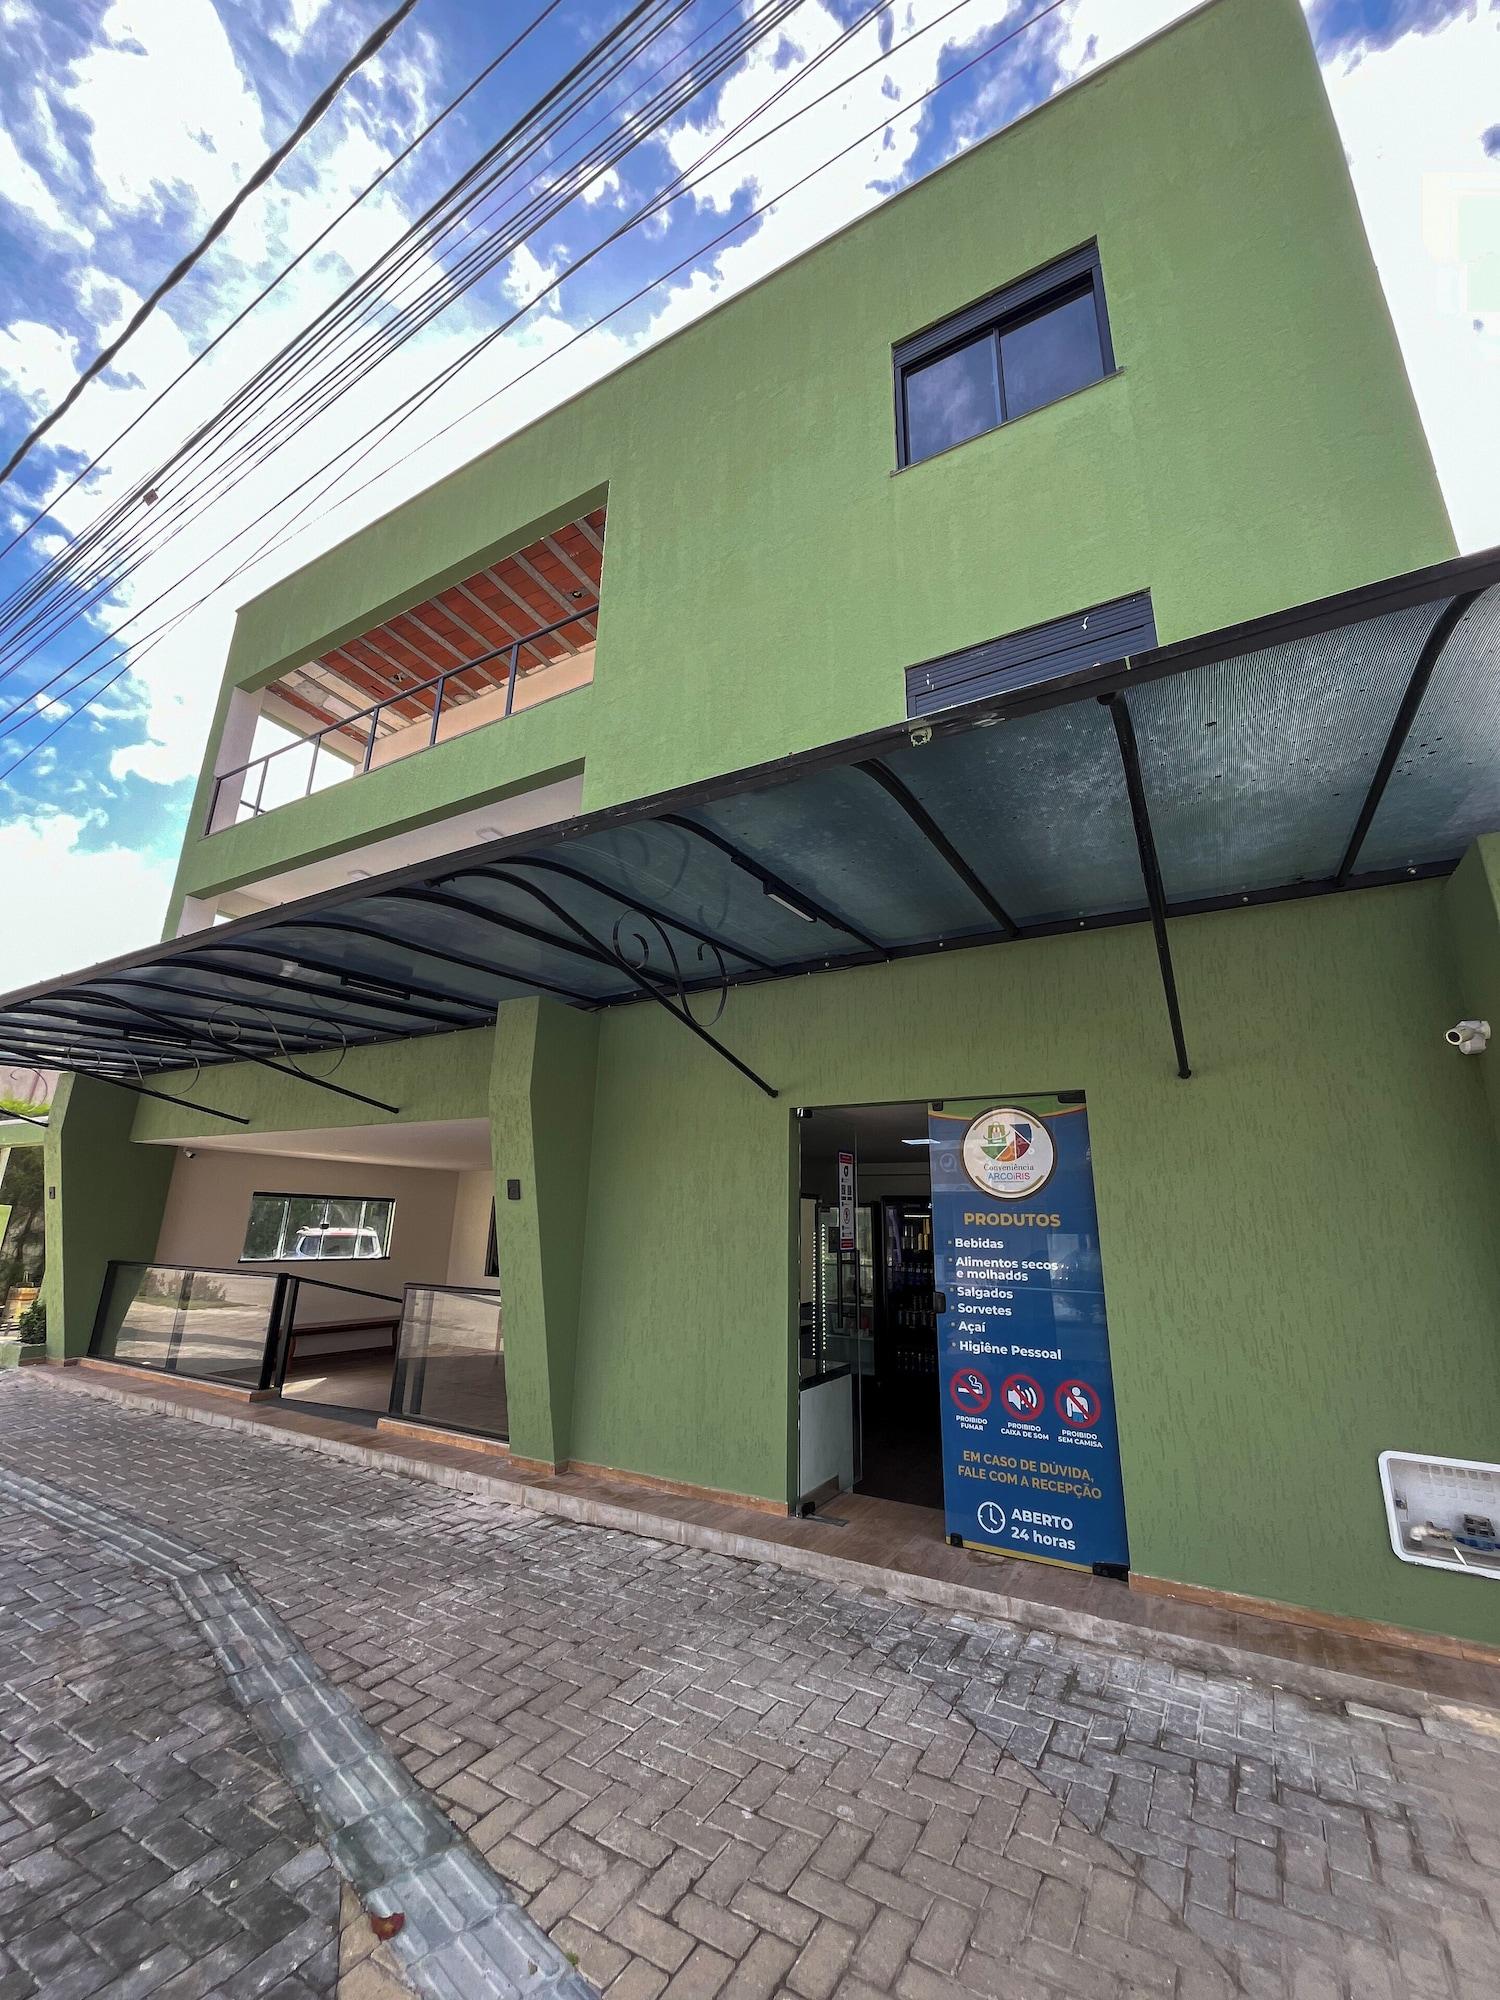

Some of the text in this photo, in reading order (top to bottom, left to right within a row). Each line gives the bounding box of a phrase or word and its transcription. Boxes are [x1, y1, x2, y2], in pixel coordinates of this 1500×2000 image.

[984, 1163, 1034, 1172] Conveniência
[964, 1212, 1061, 1227] PRODUTOS
[955, 1238, 1004, 1250] Bebidas
[956, 1256, 1058, 1271] Alimentos secos
[967, 1269, 1028, 1282] molhados
[957, 1287, 1014, 1301] Salgados
[958, 1303, 1012, 1316] Sorvetes
[958, 1321, 986, 1334] Açaí
[959, 1340, 1062, 1360] Higiêne Pessoal
[956, 1415, 987, 1425] PROIBIDO
[960, 1422, 984, 1431] FUMAR
[1008, 1422, 1041, 1432] PROIBIDO
[1001, 1428, 1049, 1440] CAIXA DE SOM
[1062, 1429, 1097, 1440] PROIBIDO
[1058, 1436, 1103, 1449] SEM CAMISA
[963, 1450, 1094, 1482] EM CASO DE DÚVIDA,
[958, 1465, 1102, 1500] FALE COM A RECEPÇÃO
[1011, 1508, 1073, 1531] ABERTO
[1011, 1527, 1076, 1550] 24 horas
